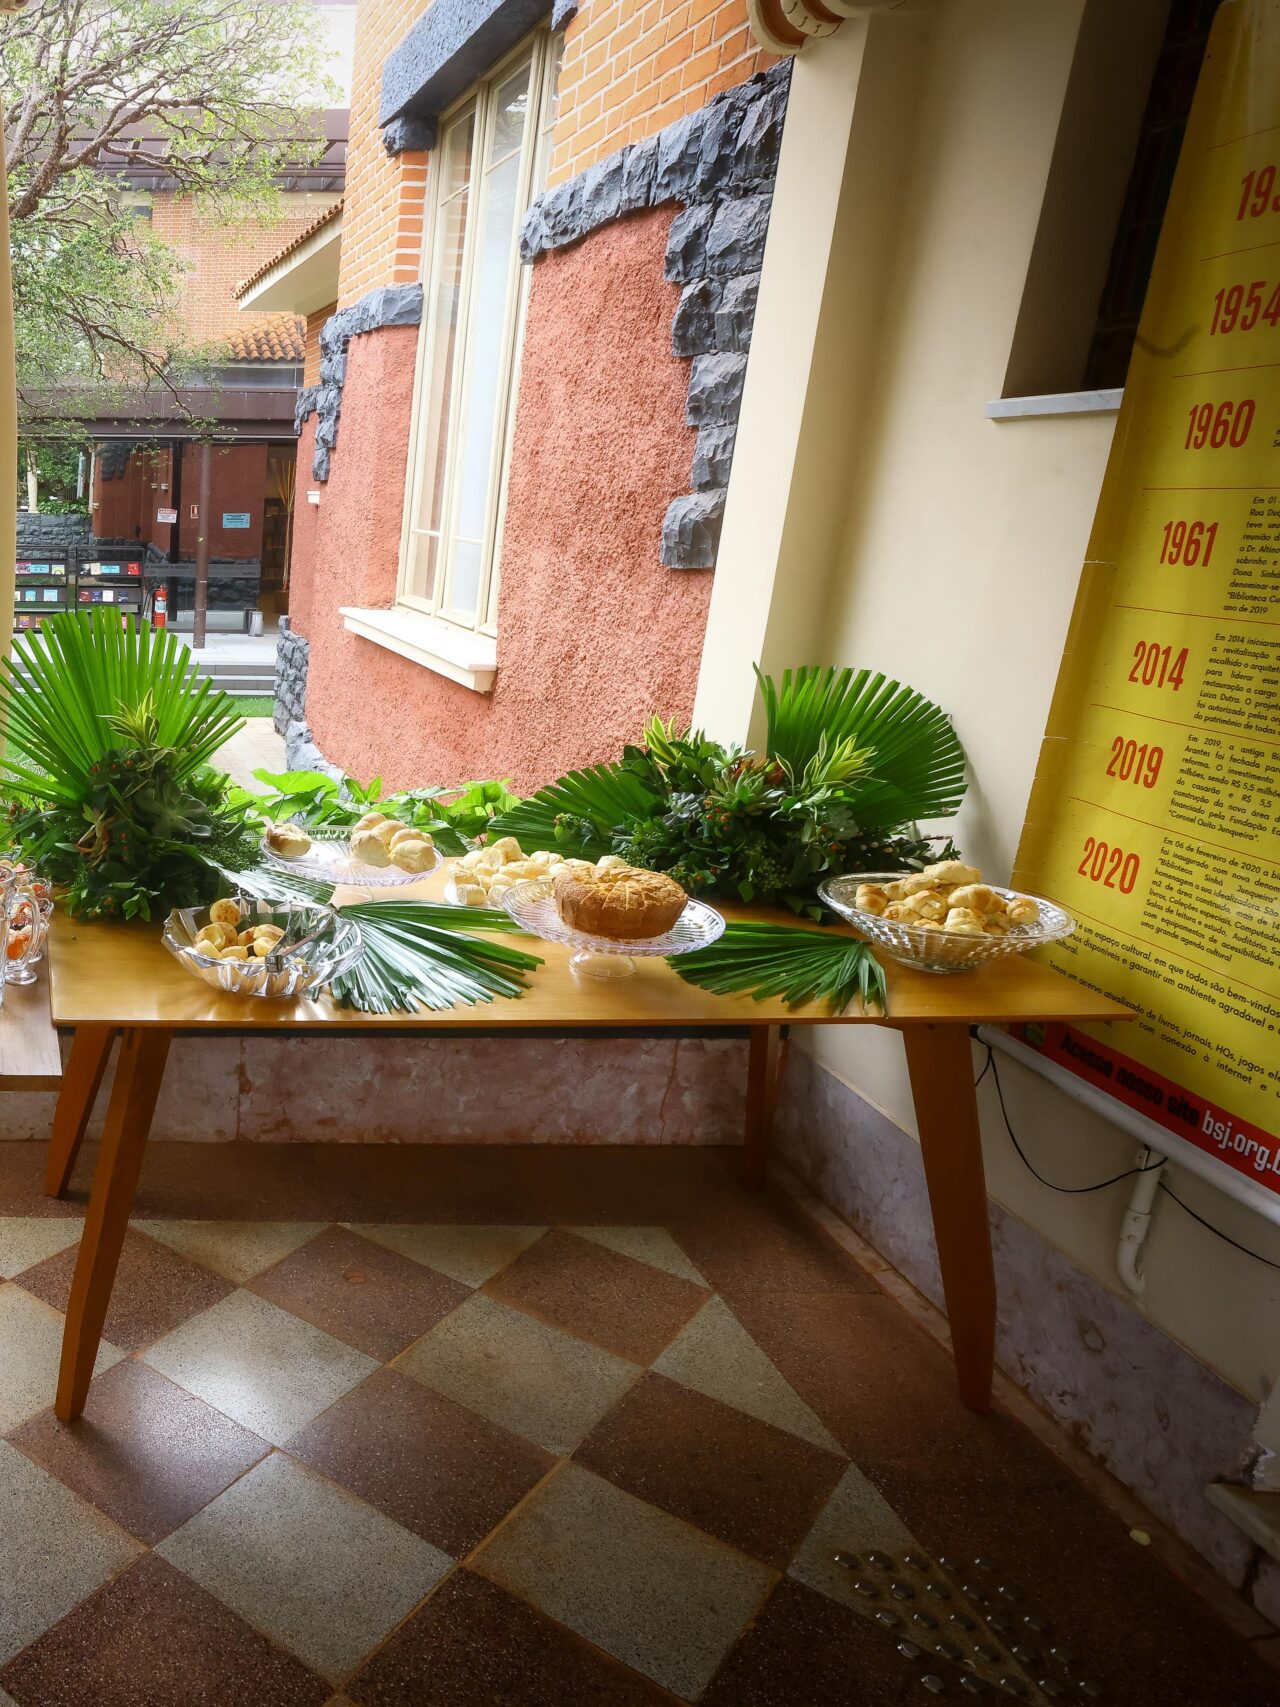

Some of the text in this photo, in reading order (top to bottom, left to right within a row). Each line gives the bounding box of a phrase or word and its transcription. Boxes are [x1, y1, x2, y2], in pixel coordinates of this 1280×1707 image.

[1210, 281, 1280, 336] 1954
[1185, 400, 1256, 449] 1960
[1253, 496, 1265, 504] Em
[1160, 521, 1219, 567] 1961
[1243, 533, 1271, 541] reunião
[1233, 568, 1252, 576] Dona
[1236, 556, 1267, 565] sobrinho
[1230, 579, 1279, 590] denominar-se
[1239, 604, 1248, 612] de
[1215, 633, 1245, 643] Em 2014
[1223, 647, 1270, 660] revitalização
[1128, 640, 1189, 692] 2014
[1205, 669, 1279, 686] para liderar esse
[1209, 657, 1243, 668] escolhido
[1200, 690, 1218, 700] Luiza
[1245, 697, 1252, 706] O
[1202, 680, 1277, 699] restauração cargo
[1193, 711, 1276, 735] do patrimônio de todas
[1197, 700, 1207, 709] foi
[1208, 704, 1246, 717] autorizado
[1247, 711, 1268, 720] pelos
[1184, 745, 1210, 757] Arantes
[1215, 751, 1225, 760] foi
[1230, 754, 1260, 769] fechada
[1188, 734, 1198, 743] Em
[1204, 737, 1222, 749] 2019,
[1240, 747, 1265, 759] antiga
[1106, 736, 1164, 789] 2019
[1182, 757, 1274, 784] reforma. O investimento
[1176, 777, 1185, 786] do
[1191, 783, 1221, 795] casarão
[1259, 798, 1272, 808] 5,5
[1179, 767, 1206, 781] milhões,
[1208, 774, 1229, 785] sendo
[1231, 779, 1241, 788] R$
[1243, 782, 1255, 792] 5,5
[1170, 797, 1205, 815] financiado
[1208, 811, 1225, 821] pela
[1230, 815, 1267, 832] Fundação
[1173, 789, 1270, 820] construção da nova área
[1197, 818, 1216, 830] Quito
[1077, 836, 1140, 895] 2020
[1160, 846, 1250, 883] foi inaugurado com nova
[1163, 836, 1173, 846] Em
[1175, 841, 1184, 849] 06
[1185, 844, 1195, 853] de
[1196, 846, 1227, 863] fevereiro
[1228, 858, 1239, 867] de
[1241, 861, 1261, 874] 2020
[1263, 869, 1269, 877] a
[1154, 867, 1279, 918] homenagem sua idealizadora. São
[1204, 874, 1223, 886] Sinhá
[1148, 888, 1166, 901] livros,
[1168, 896, 1198, 913] Coleções
[1199, 909, 1232, 926] especiais,
[1164, 883, 1173, 892] de
[1176, 887, 1192, 899] área
[1236, 910, 1253, 922] mais
[1256, 916, 1268, 926] de
[1140, 920, 1233, 962] uma grande agenda cultural
[1143, 910, 1158, 920] com
[1160, 916, 1205, 939] equipamentos
[1208, 935, 1218, 944] de
[1221, 941, 1275, 967] acessibilidade
[1145, 899, 1163, 911] Salas
[1164, 906, 1174, 914] de
[1175, 909, 1196, 924] leitura
[1203, 922, 1228, 937] estudo,
[1232, 932, 1268, 952] Auditório,
[1055, 938, 1079, 955] cultural.
[1083, 927, 1094, 936] um
[1094, 931, 1120, 948] espaço
[1121, 944, 1152, 962] cultural,
[1154, 958, 1167, 968] em
[1168, 964, 1184, 975] que
[1186, 970, 1208, 987] todos
[1210, 982, 1225, 994] são
[1083, 937, 1275, 1032] disponíveis e garantir um ambiente agradável e
[1049, 960, 1265, 1075] Temos um acervo atualizado de livros, jornais, HQs, jogos
[1138, 1022, 1155, 1035] com
[1160, 1032, 1197, 1056] conexão
[1203, 1053, 1210, 1063] à
[1216, 1059, 1253, 1085] internet
[1060, 1031, 1115, 1080] Acesse
[1115, 1065, 1164, 1107] nosso
[1166, 1093, 1201, 1130] site
